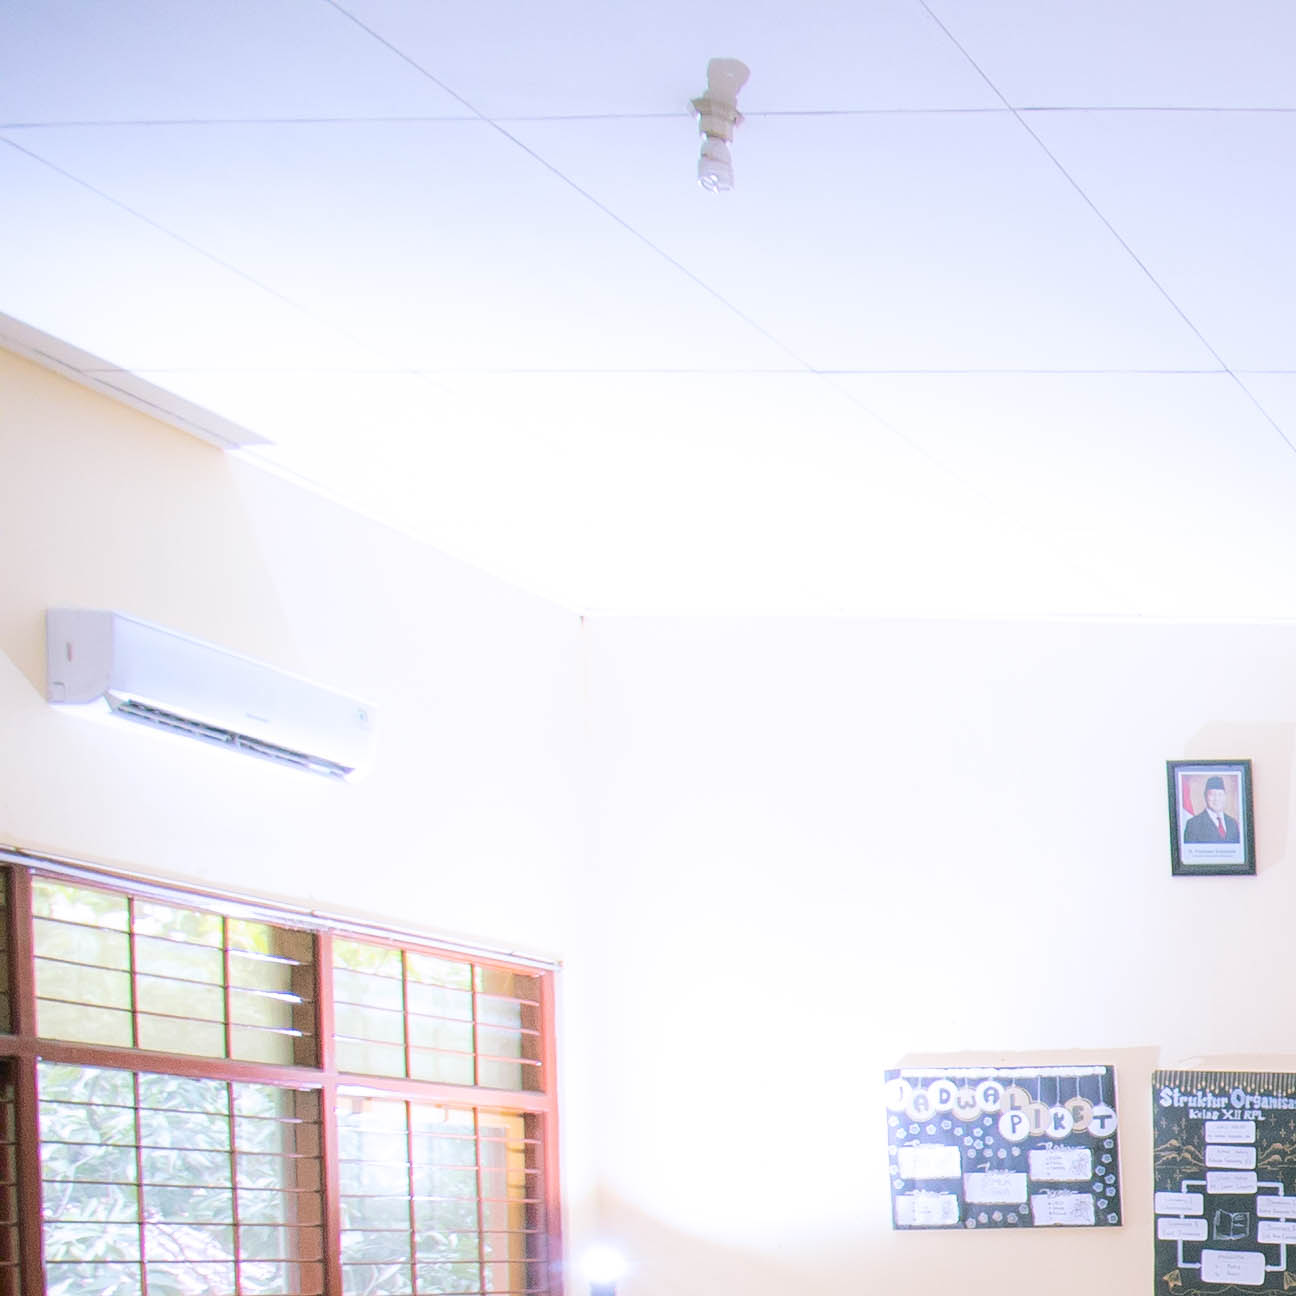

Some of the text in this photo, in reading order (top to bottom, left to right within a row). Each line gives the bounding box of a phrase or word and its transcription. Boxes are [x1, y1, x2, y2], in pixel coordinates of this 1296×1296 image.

[1159, 1087, 1228, 1108] Struktur
[1009, 1104, 1113, 1135] PIKET
[1188, 1108, 1267, 1121] Kelas XII RPL
